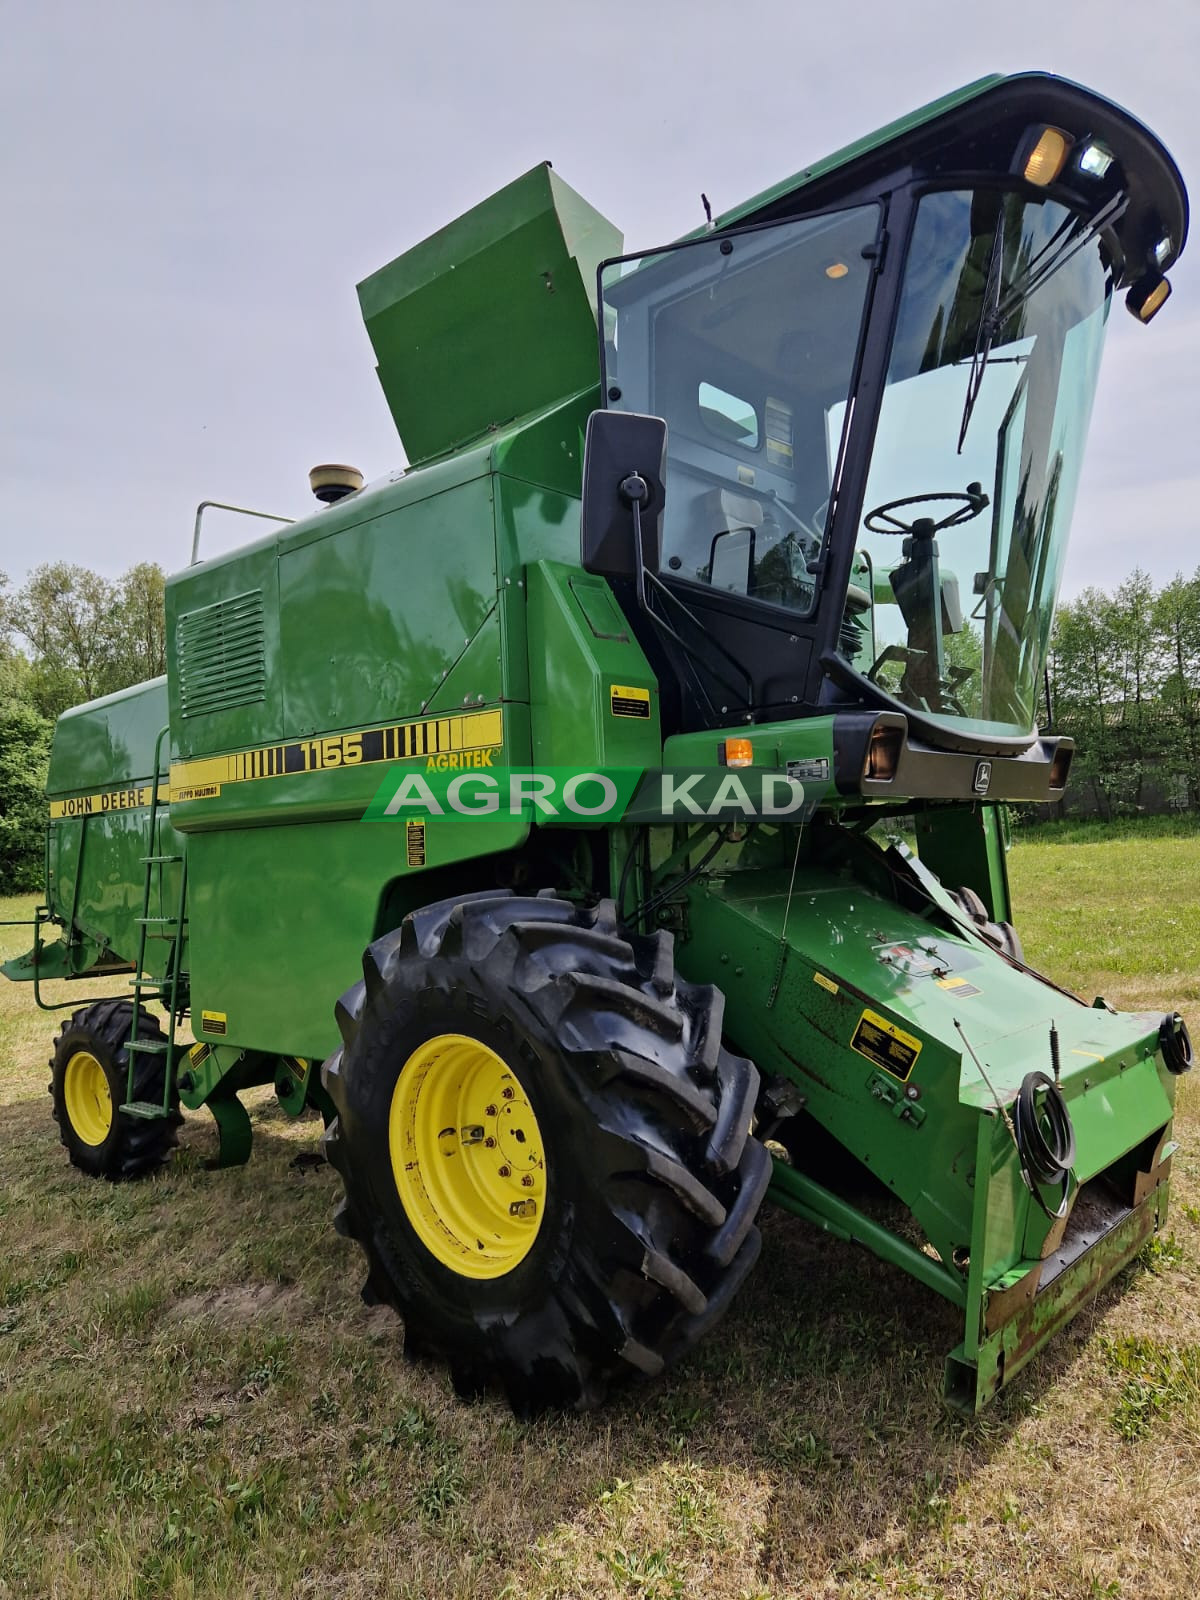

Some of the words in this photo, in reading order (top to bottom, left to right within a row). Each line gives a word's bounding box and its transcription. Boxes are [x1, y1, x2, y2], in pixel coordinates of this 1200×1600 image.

[300, 733, 364, 770] 1155
[426, 748, 493, 774] AGRITEK
[61, 797, 92, 816] JOHN
[101, 789, 145, 810] DEERE
